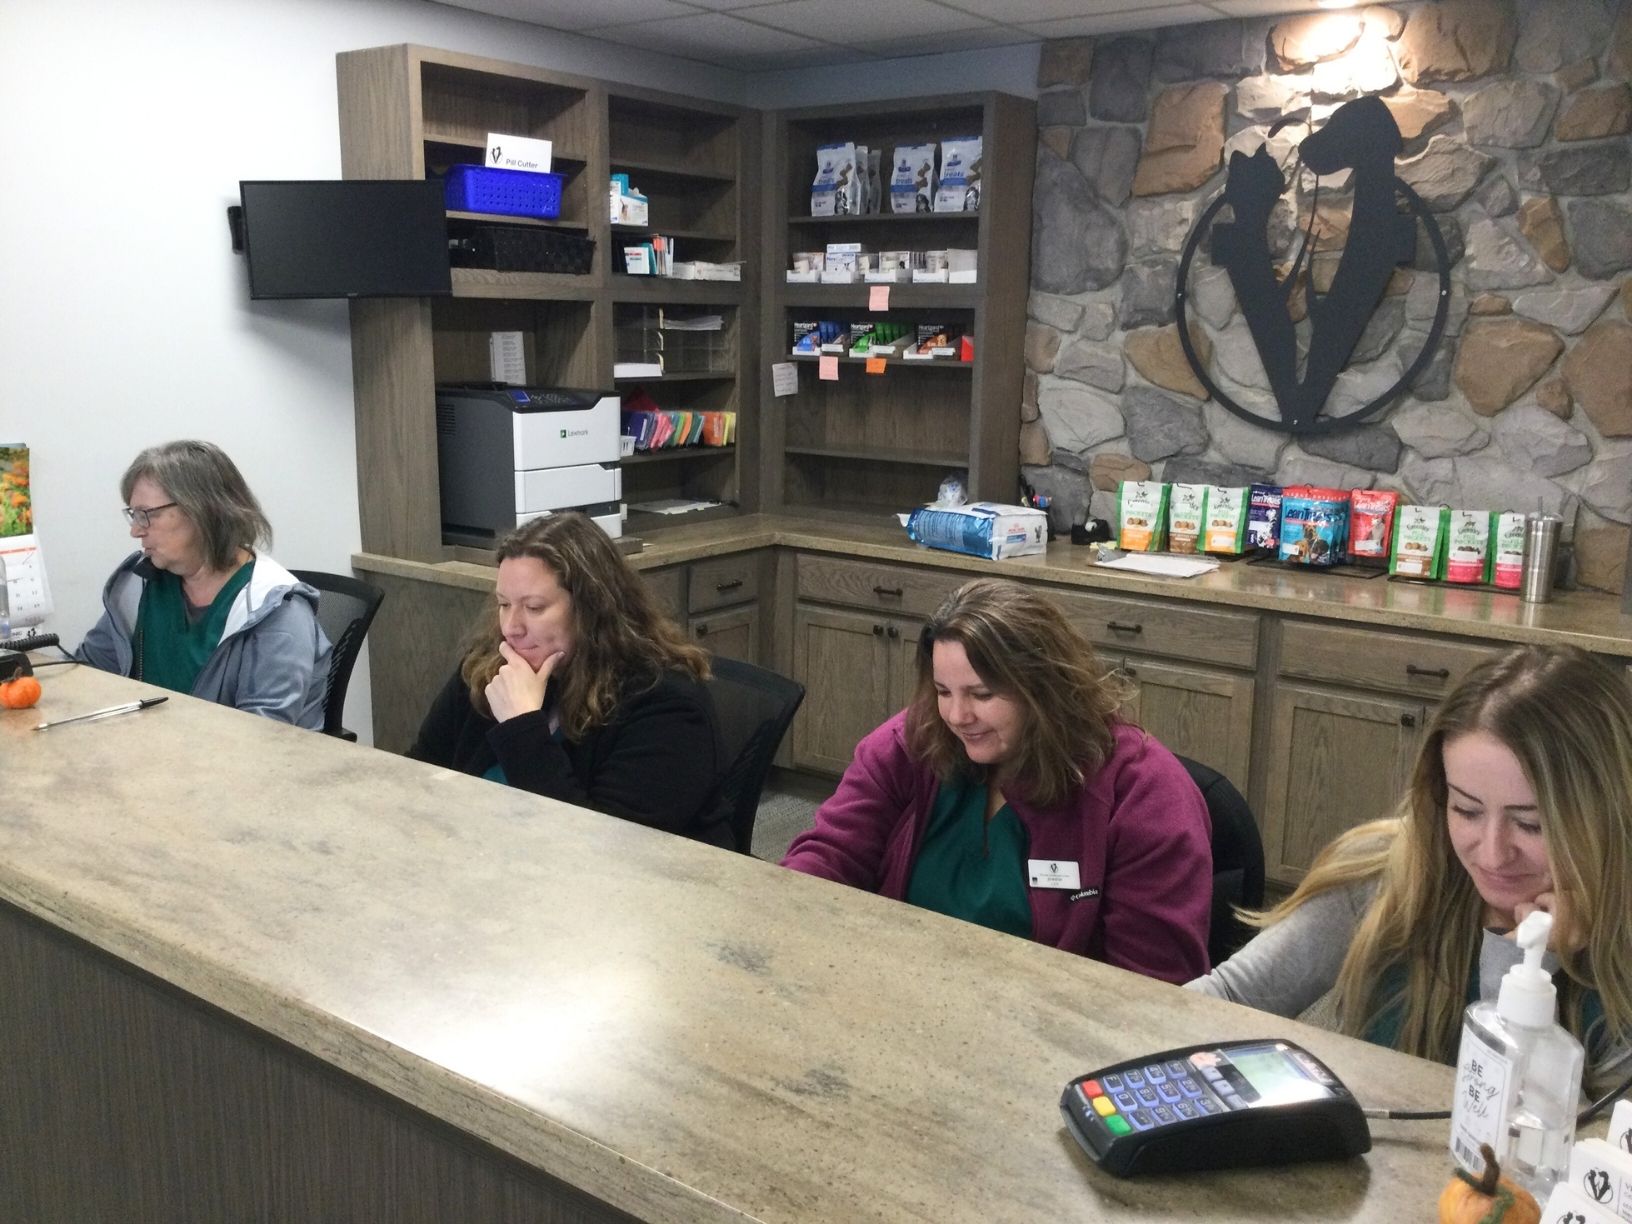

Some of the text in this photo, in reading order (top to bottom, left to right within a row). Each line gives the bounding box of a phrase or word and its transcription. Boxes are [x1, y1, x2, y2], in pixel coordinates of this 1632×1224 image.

[506, 158, 538, 168] Pill Cutter
[1471, 1059, 1483, 1078] BE
[1469, 1084, 1481, 1104] BE
